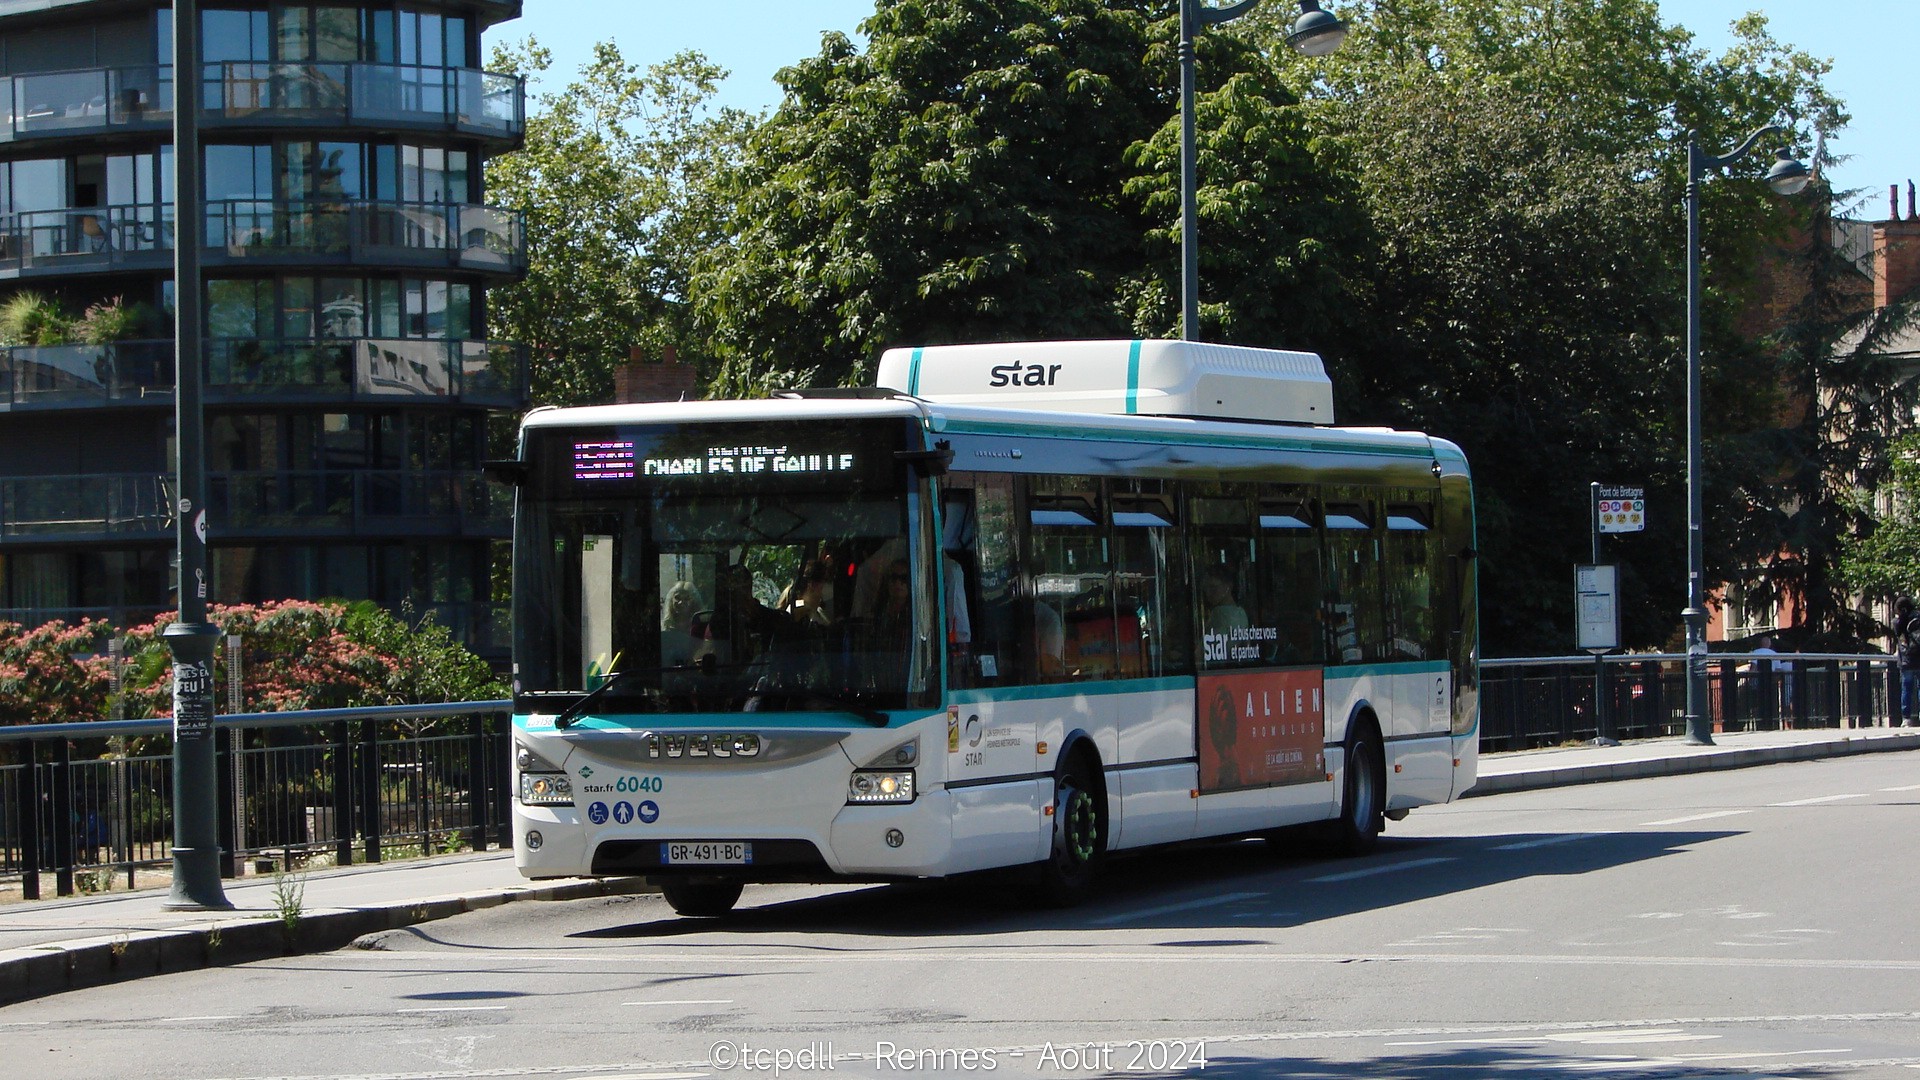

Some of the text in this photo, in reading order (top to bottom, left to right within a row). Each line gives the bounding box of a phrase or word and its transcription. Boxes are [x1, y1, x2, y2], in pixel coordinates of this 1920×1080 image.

[989, 359, 1062, 388] star
[1599, 485, 1643, 500] Pont de Bretagne
[1230, 624, 1277, 640] Le bus chez vous
[1203, 627, 1228, 661] star
[1231, 643, 1260, 662] et partout
[1246, 687, 1320, 717] ALIEN
[1252, 722, 1315, 738] ROMULUS
[649, 733, 760, 758] IVECO
[965, 752, 983, 767] STAR
[584, 776, 663, 793] star.fr 6040
[671, 844, 742, 860] GR-491-BC
